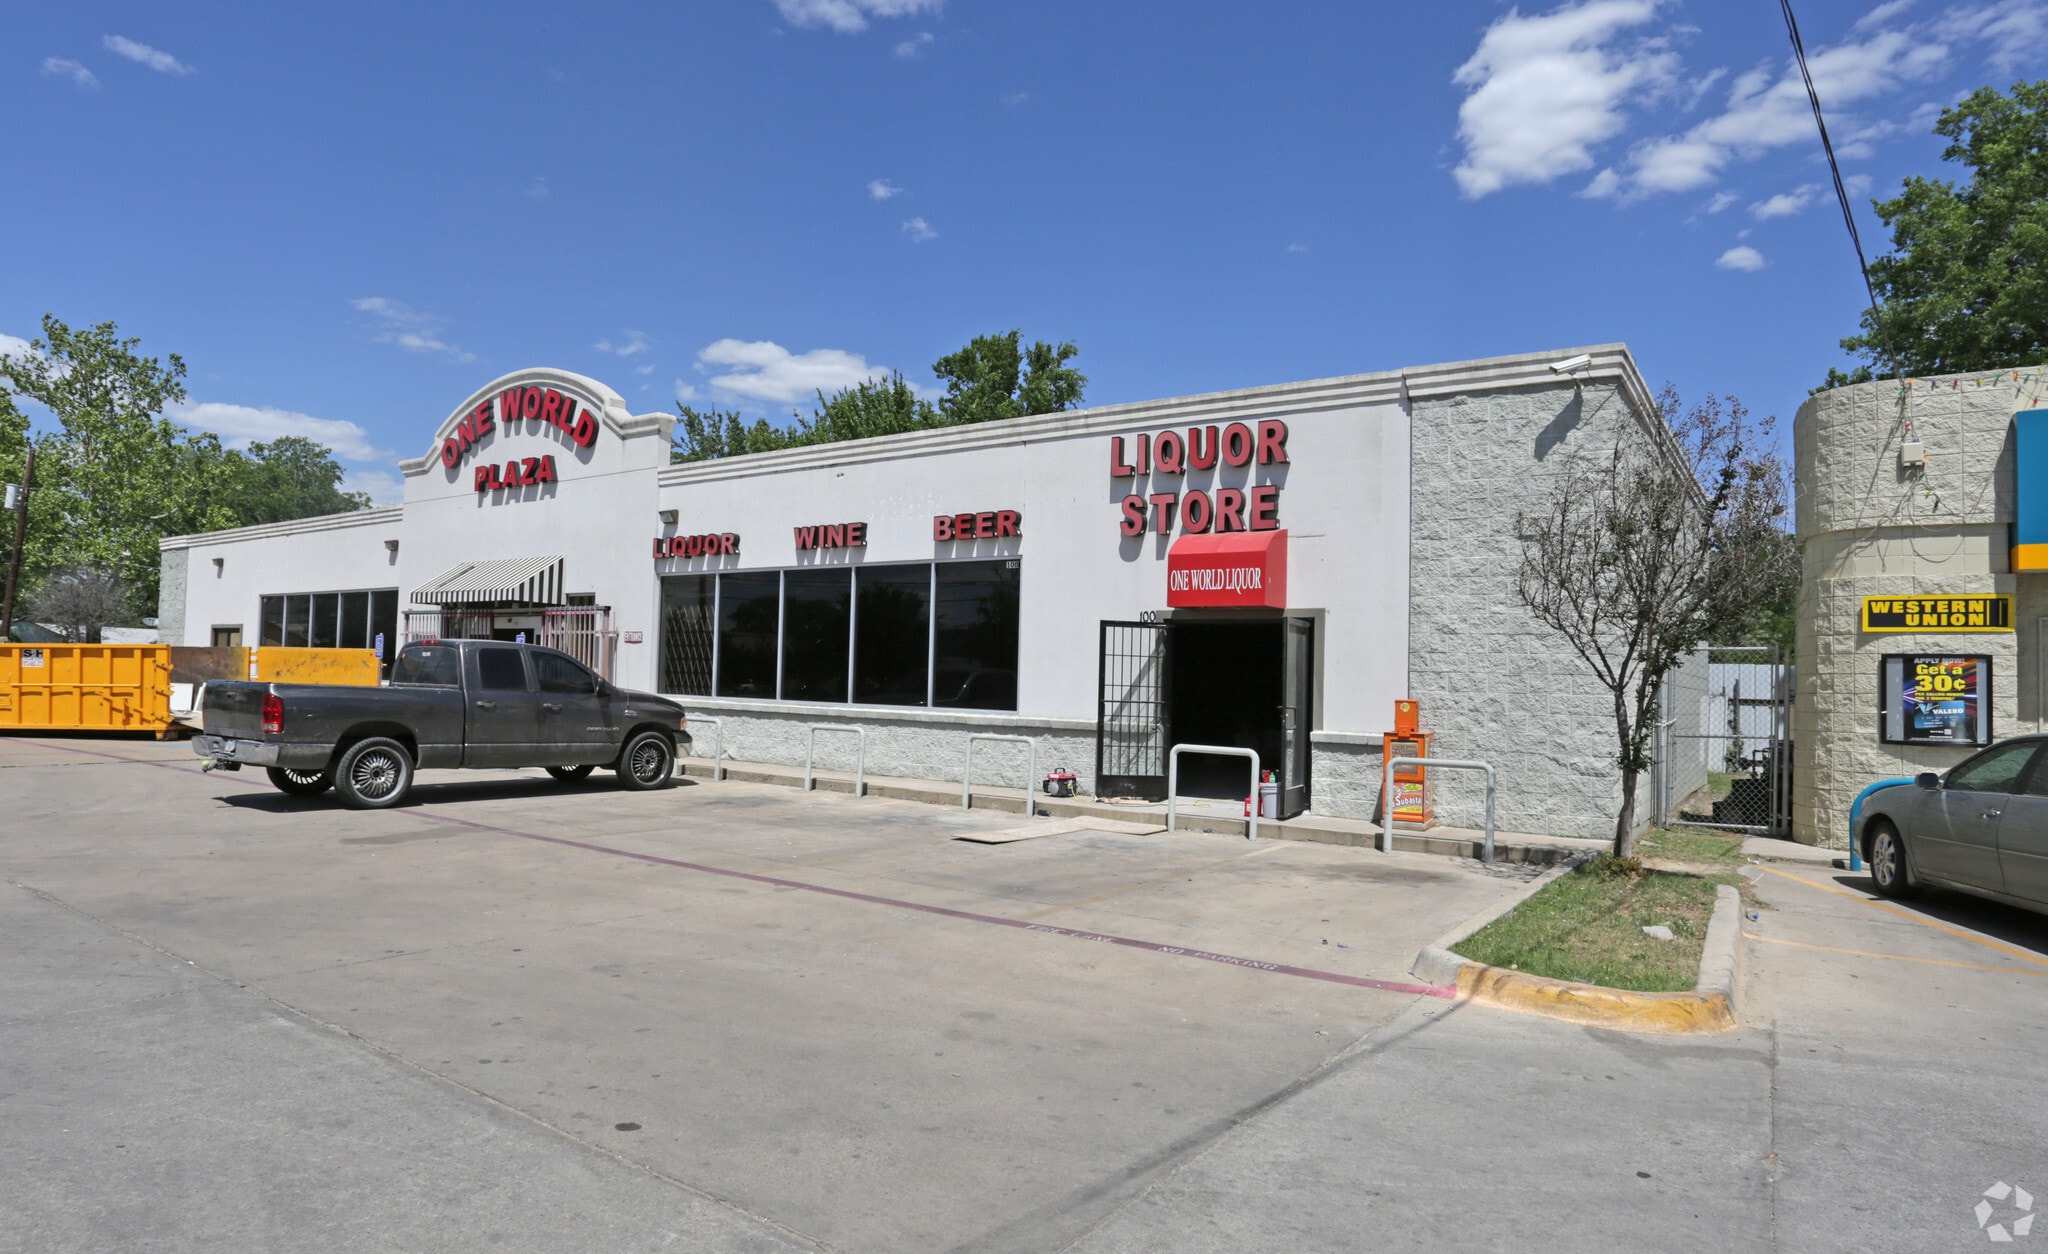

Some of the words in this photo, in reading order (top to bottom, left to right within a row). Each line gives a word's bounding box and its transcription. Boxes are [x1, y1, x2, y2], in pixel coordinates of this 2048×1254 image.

[441, 400, 493, 469] ONE
[500, 386, 599, 448] WORLD
[1110, 419, 1290, 477] LIQUOR
[474, 454, 555, 492] PLAZA
[1120, 485, 1281, 537] STORE
[794, 522, 868, 550] WINE
[933, 510, 1022, 541] BEER
[653, 533, 740, 559] LIQUOR
[1170, 568, 1189, 591] ONE
[1190, 568, 1225, 591] WORLD
[1225, 566, 1262, 594] LIQUOR
[1139, 610, 1157, 623] 100
[1870, 600, 1985, 614] WESTERN
[1905, 613, 1985, 626] UNION
[1916, 664, 1947, 675] Get
[1951, 666, 1963, 675] a
[1395, 795, 1422, 806] Subasta
[1158, 946, 1185, 954] NO
[1194, 951, 1279, 970] PARKING
